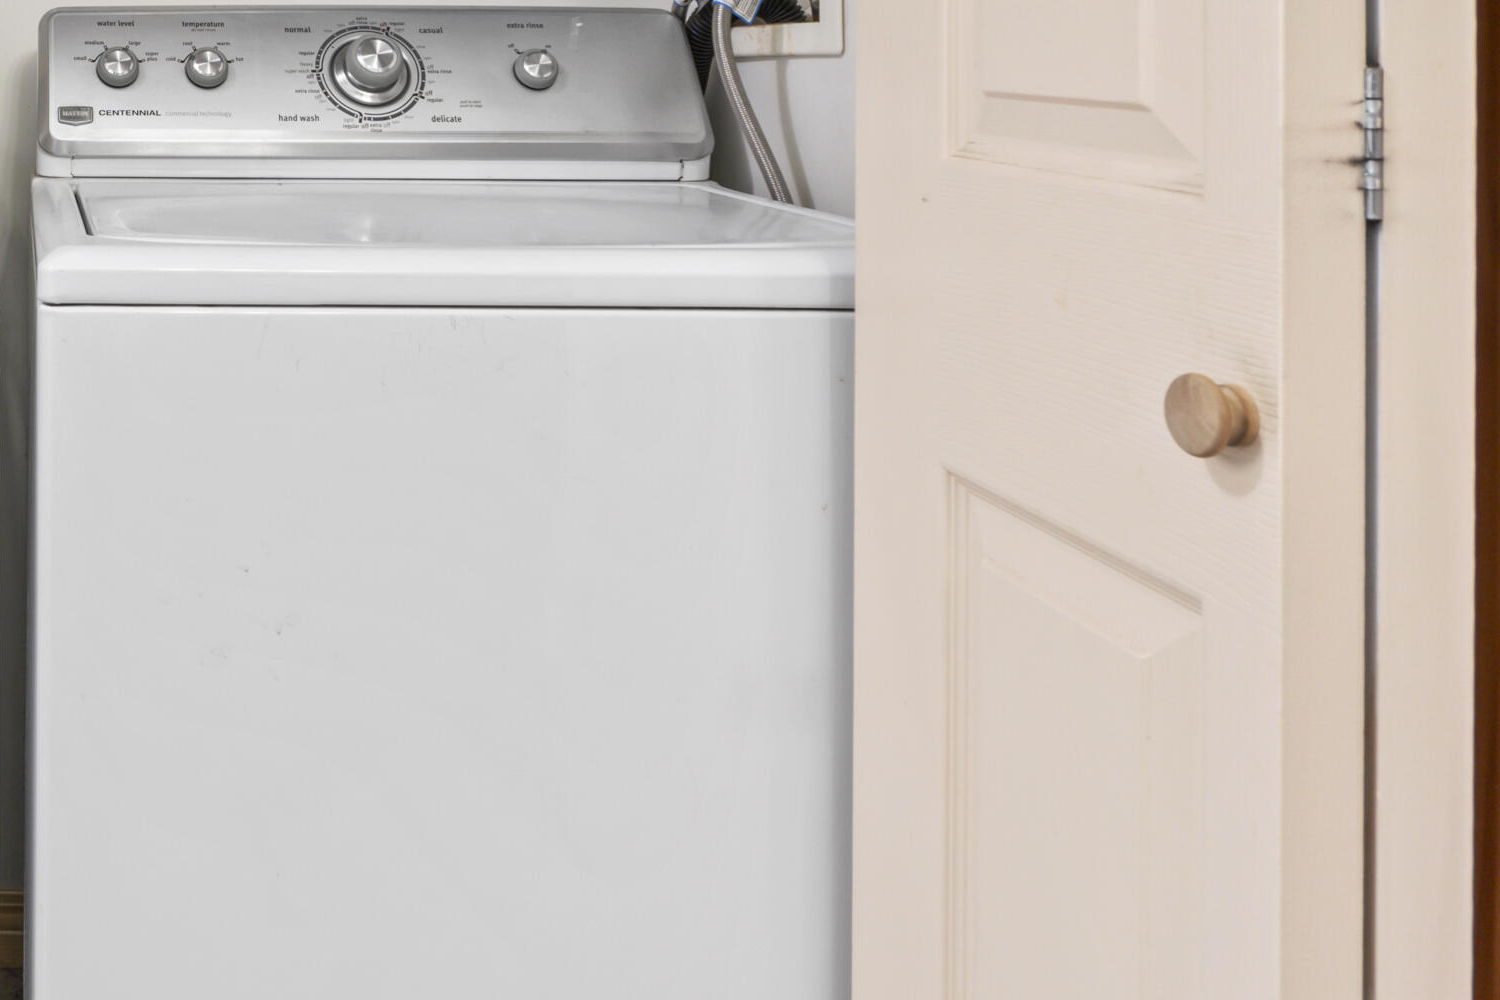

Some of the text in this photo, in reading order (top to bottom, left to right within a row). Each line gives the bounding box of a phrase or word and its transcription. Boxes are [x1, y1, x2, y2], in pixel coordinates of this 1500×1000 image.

[98, 109, 161, 117] CENTENNIAL
[278, 114, 298, 122] hand
[431, 115, 462, 123] delicate
